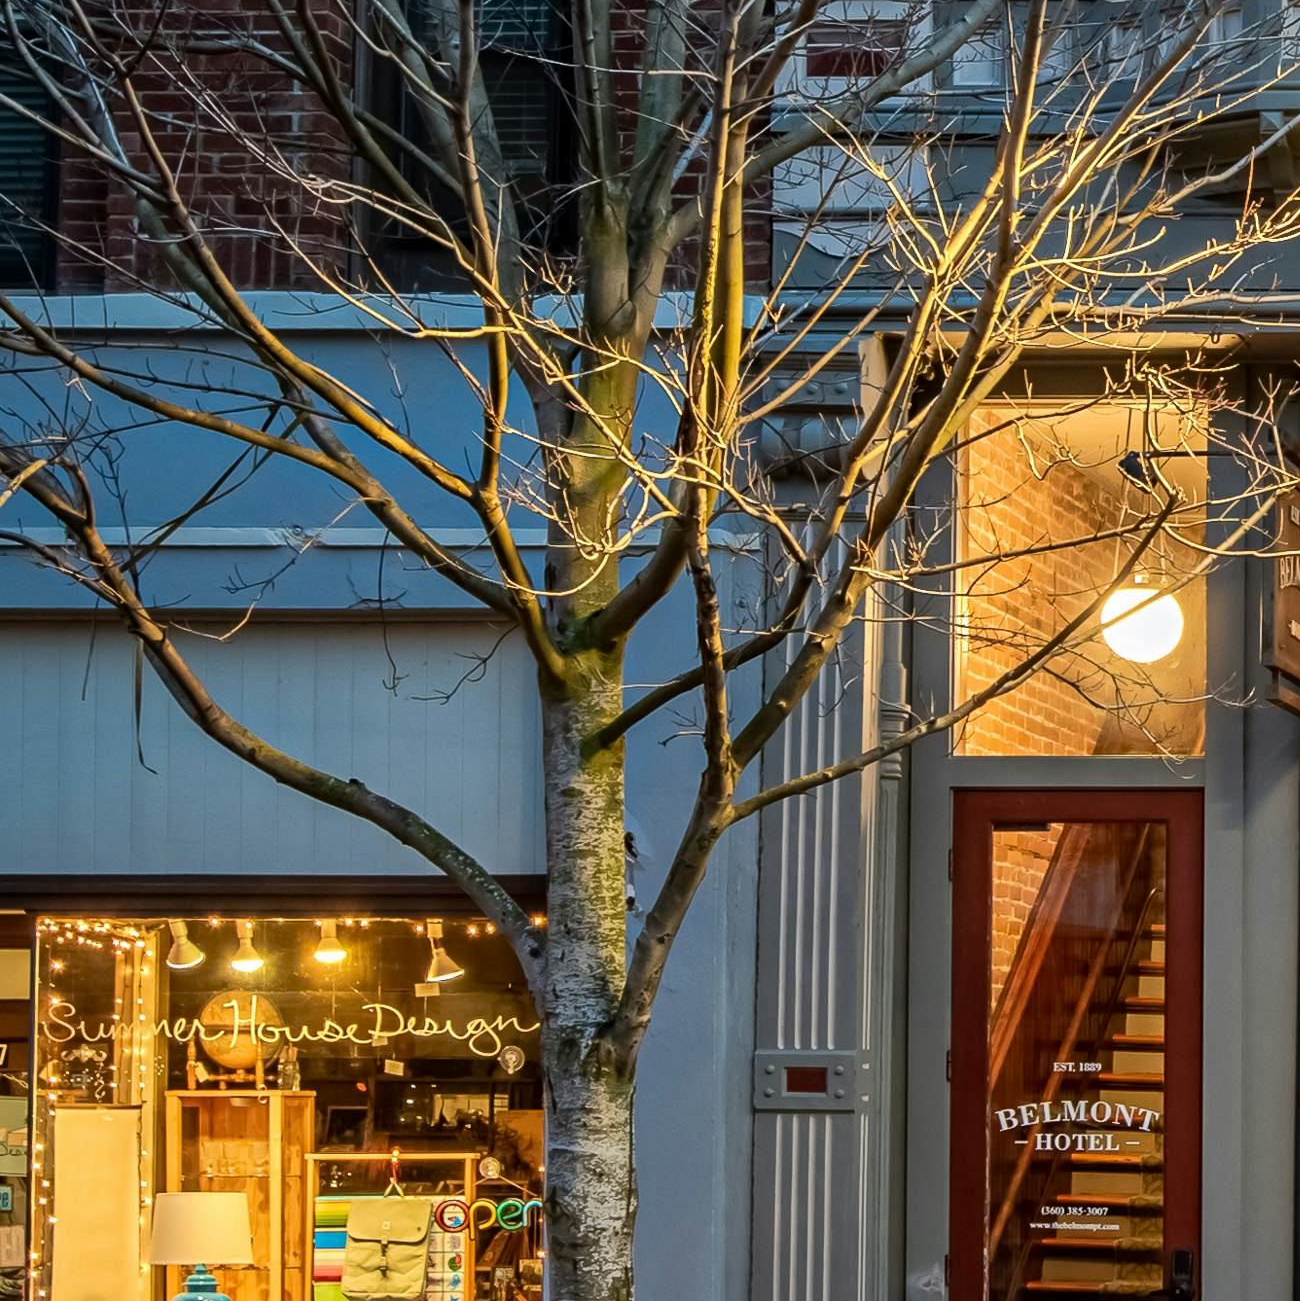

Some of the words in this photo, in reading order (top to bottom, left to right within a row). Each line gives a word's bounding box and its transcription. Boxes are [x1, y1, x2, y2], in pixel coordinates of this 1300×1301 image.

[41, 1001, 226, 1043] Summer
[223, 994, 373, 1049] House
[361, 1003, 541, 1057] Design
[1079, 1061, 1103, 1073] 1889
[994, 1099, 1161, 1133] BELMONT
[1034, 1132, 1121, 1152] HOTEL
[1041, 1206, 1065, 1217] (360)
